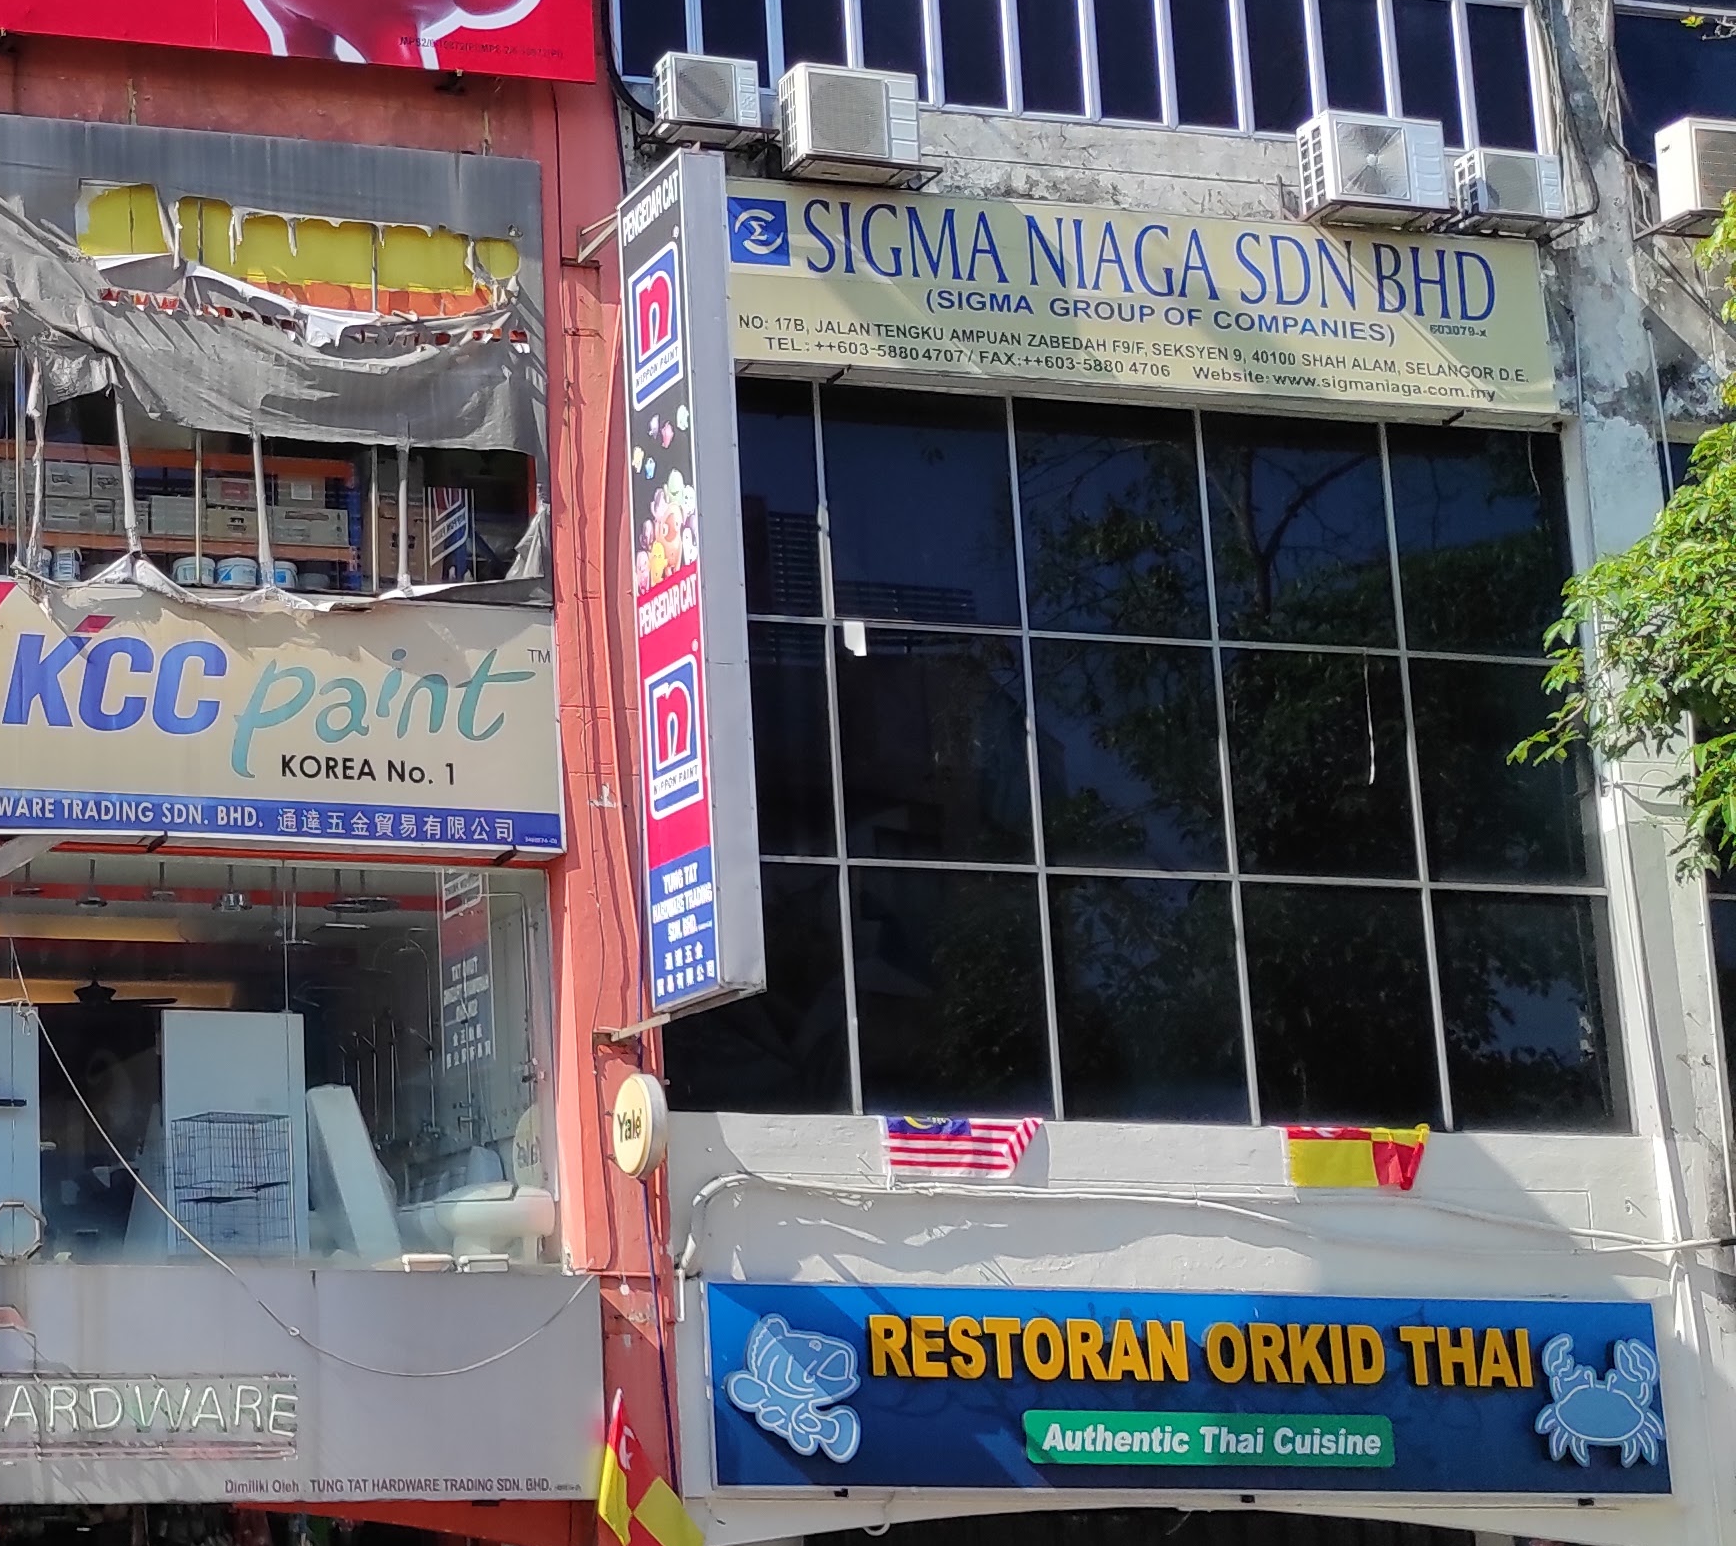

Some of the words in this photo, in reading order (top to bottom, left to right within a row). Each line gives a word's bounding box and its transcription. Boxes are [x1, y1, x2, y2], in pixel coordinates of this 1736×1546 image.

[622, 189, 662, 248] PENGEDAR
[662, 168, 680, 210] CAT
[804, 196, 1013, 288] SIGMA
[1026, 213, 1223, 307] NIAGA
[1236, 230, 1356, 311] SDN
[1372, 241, 1498, 325] BHD
[739, 313, 770, 330] NO:
[774, 316, 810, 335] 17B,
[814, 318, 870, 337] JALAN
[873, 322, 945, 342] TENGKU
[949, 327, 1022, 348] AMPUAN
[1027, 333, 1108, 354] ZABEDAH
[1152, 342, 1230, 363] SEKSYEN
[1251, 349, 1297, 367] 40100
[1302, 353, 1347, 371] SHAH
[1351, 355, 1402, 376] ALAM,
[1405, 359, 1495, 381] SELANGOR
[1499, 365, 1530, 383] D.E.
[924, 286, 1034, 321] (SIGMA
[1049, 296, 1156, 328] GROUP
[1164, 303, 1203, 330] OF
[1211, 308, 1398, 349] COMPANIES)
[764, 336, 811, 353] TEL:
[1128, 361, 1171, 378] 4706
[1272, 372, 1497, 404] www.sigmaniaga.com.my
[639, 584, 681, 638] PENGEDAR
[680, 573, 697, 617] CAT
[2, 613, 228, 735] KCC
[230, 648, 536, 779] paint
[281, 754, 376, 783] KOREA
[388, 759, 435, 785] No.
[444, 761, 457, 786] 1
[62, 798, 153, 824] TRADING
[161, 802, 209, 825] SDN.
[217, 806, 263, 829] BHD.
[617, 1108, 643, 1143] Yale
[869, 1313, 1190, 1383] RESTORAN
[1204, 1320, 1386, 1386] ORKID
[1398, 1324, 1533, 1389] THAI
[1040, 1422, 1189, 1456] Authentic
[1198, 1424, 1265, 1456] Thai
[1271, 1425, 1383, 1457] Cuisine
[224, 1478, 269, 1494] Dimiliki
[272, 1479, 300, 1494] Oleh
[310, 1478, 344, 1493] TUNG
[347, 1478, 370, 1493] TAT
[371, 1478, 440, 1493] HARDWARE
[443, 1477, 494, 1493] TRADING
[496, 1477, 524, 1492] SDN.
[526, 1477, 553, 1492] BHD.
